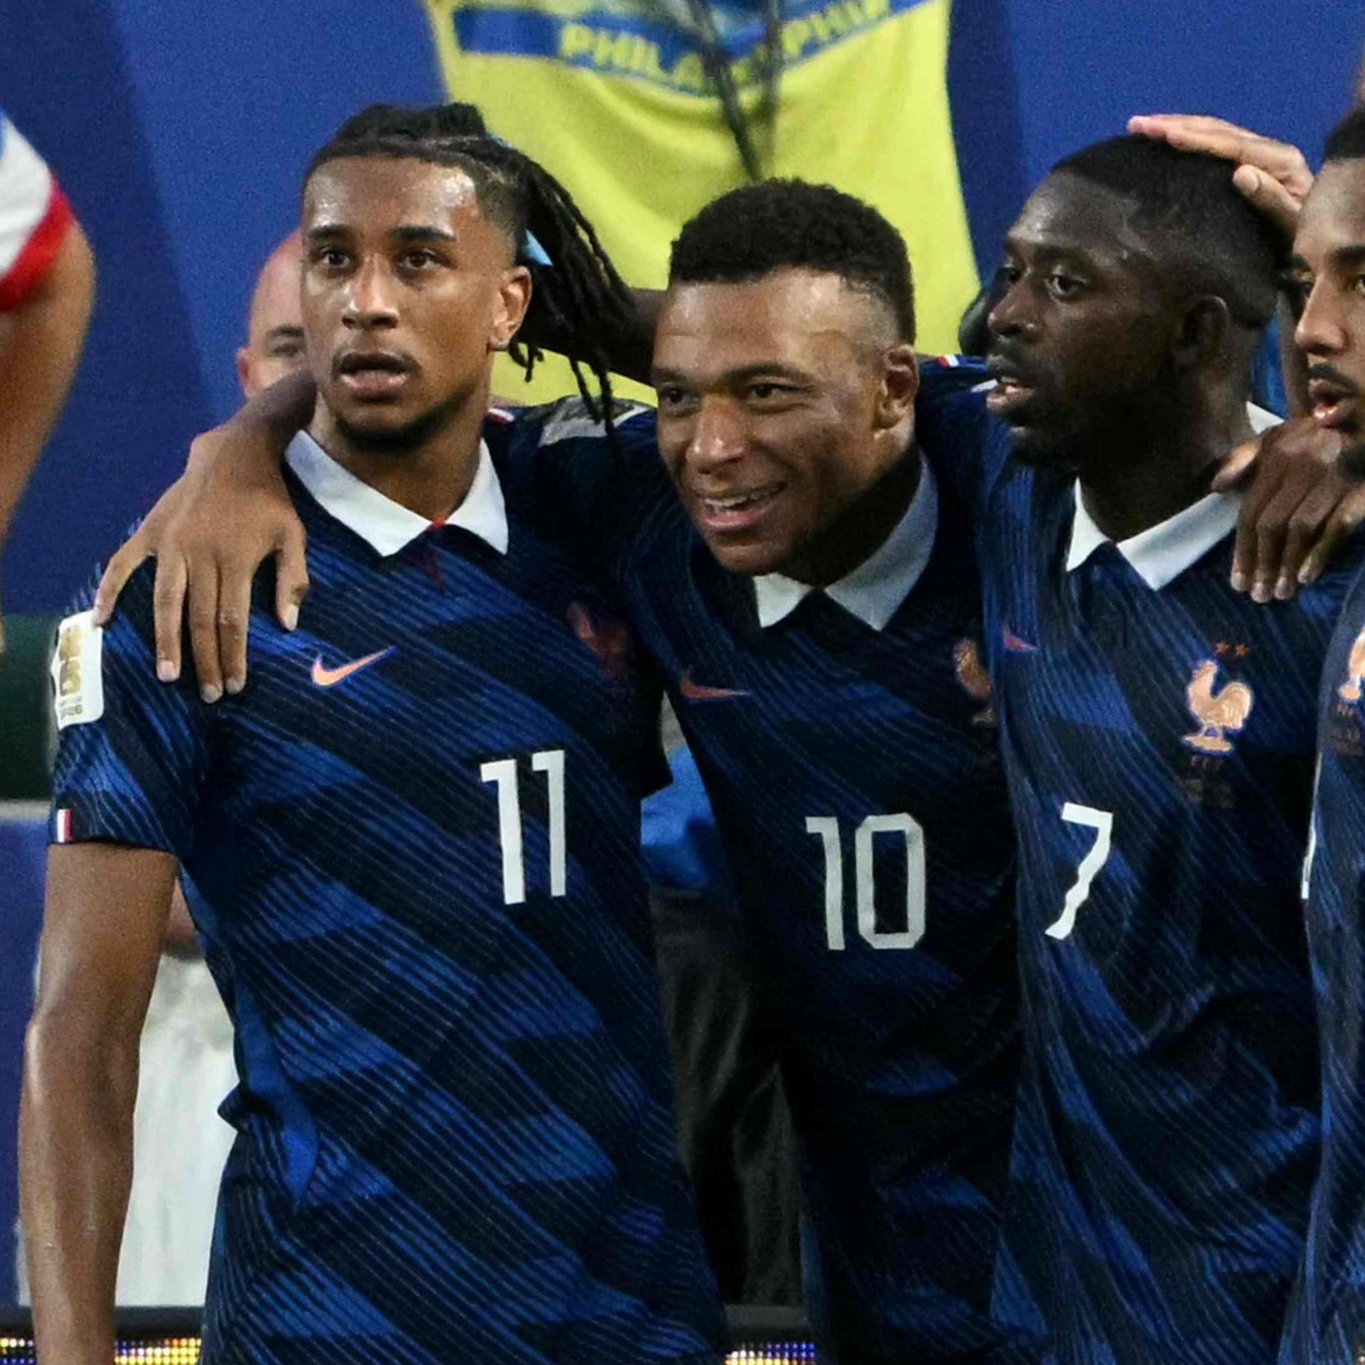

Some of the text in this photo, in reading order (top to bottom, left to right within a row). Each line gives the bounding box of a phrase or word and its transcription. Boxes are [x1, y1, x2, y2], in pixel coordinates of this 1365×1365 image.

[479, 749, 567, 905] 11
[804, 811, 926, 951] 10
[1044, 801, 1115, 941] 7
